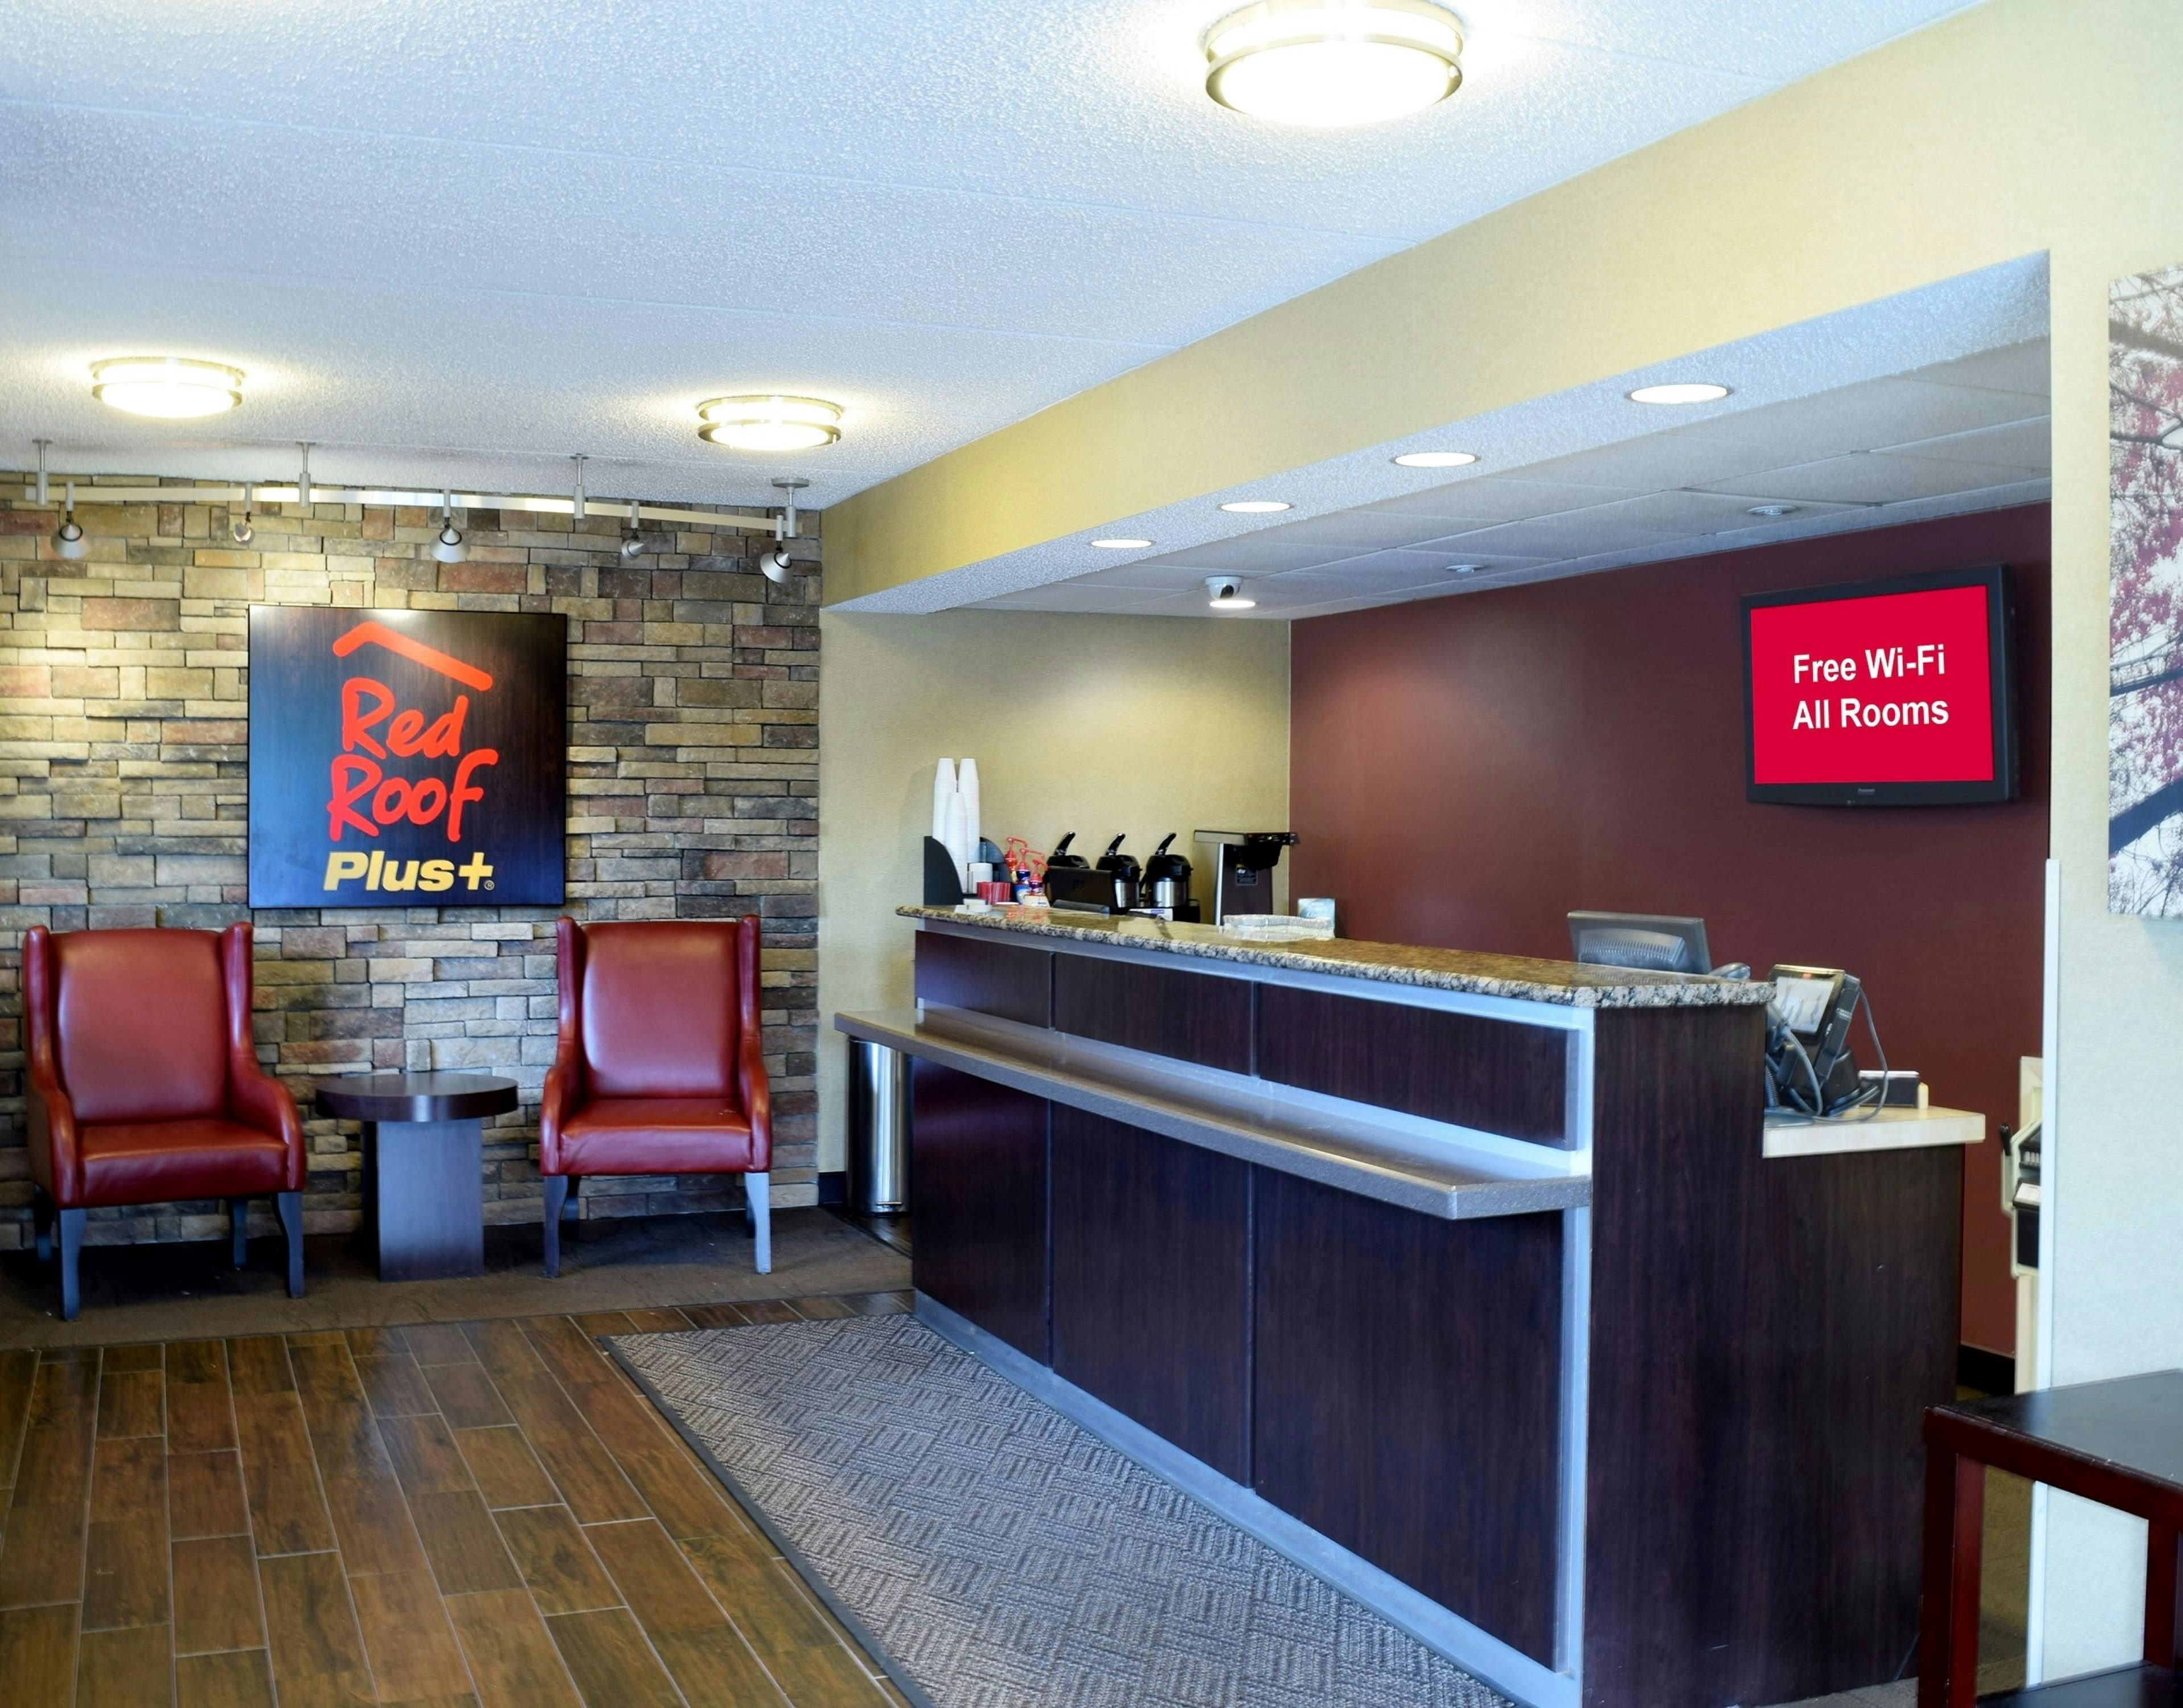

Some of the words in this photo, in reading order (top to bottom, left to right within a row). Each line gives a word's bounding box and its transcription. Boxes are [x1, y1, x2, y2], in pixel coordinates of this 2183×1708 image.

[1793, 654, 1857, 684] Free
[1865, 643, 1946, 679] Wi-Fi
[342, 677, 469, 759] Red
[1792, 700, 1830, 730] All
[1840, 697, 1950, 728] Rooms
[327, 749, 499, 842] Roof
